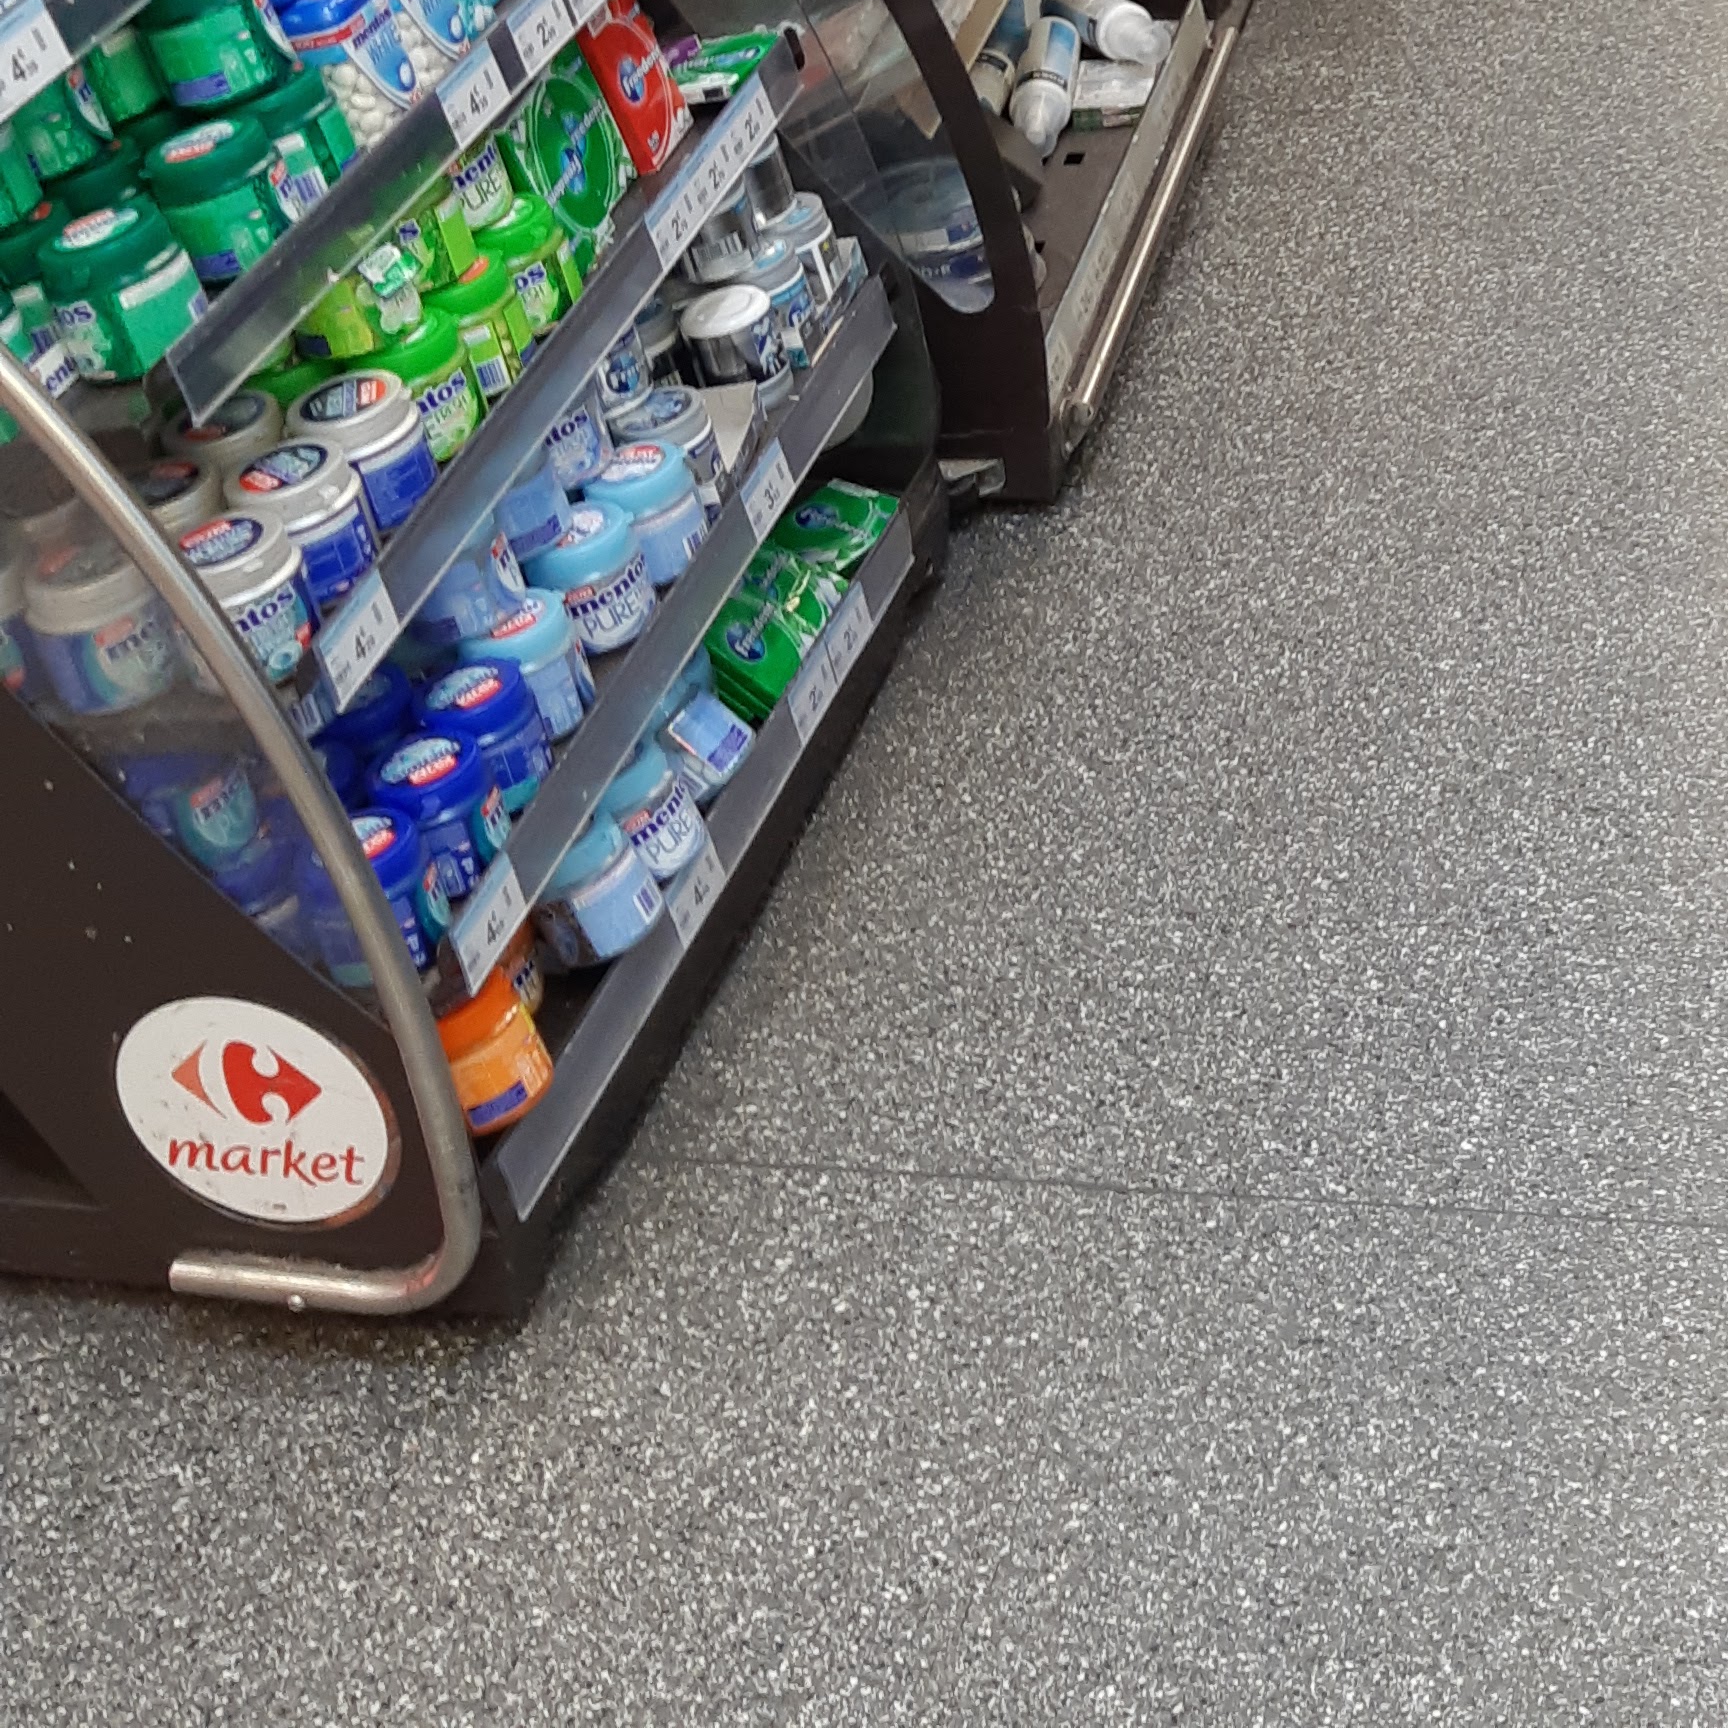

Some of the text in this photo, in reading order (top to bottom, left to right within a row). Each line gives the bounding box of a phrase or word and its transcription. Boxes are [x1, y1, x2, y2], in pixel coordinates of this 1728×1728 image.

[415, 373, 467, 414] ntos
[235, 587, 294, 633] ntos
[568, 552, 648, 619] mento
[580, 592, 641, 639] PURE
[631, 780, 684, 847] ment
[645, 810, 692, 865] PURE
[167, 1137, 365, 1187] market
